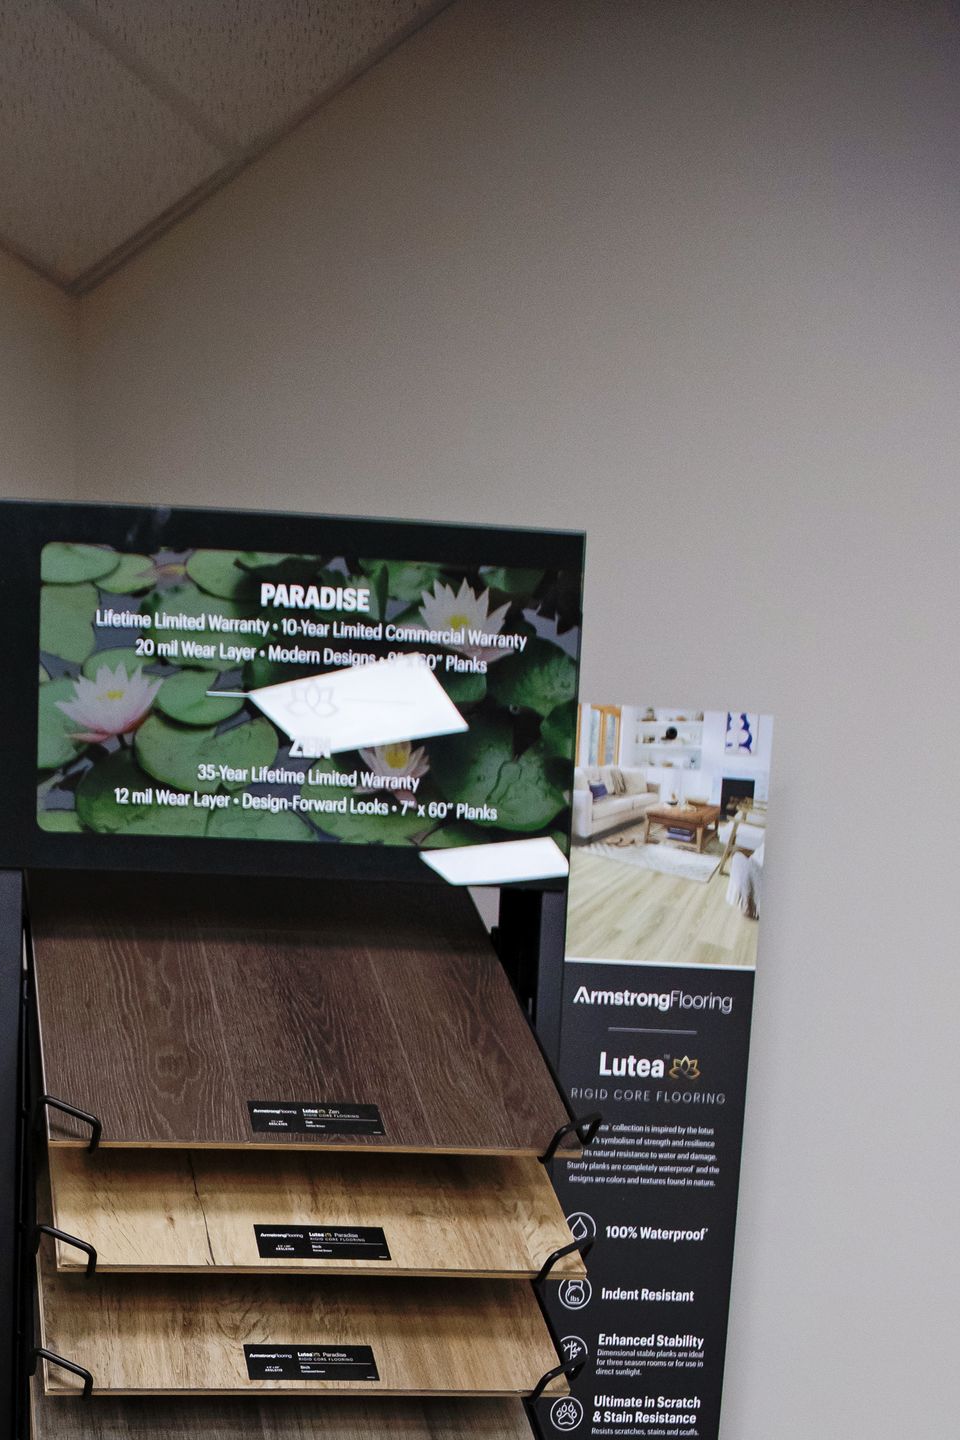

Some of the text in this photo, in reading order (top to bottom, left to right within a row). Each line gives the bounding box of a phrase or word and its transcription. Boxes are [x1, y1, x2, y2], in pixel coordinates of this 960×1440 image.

[260, 582, 370, 613] PARADISE
[95, 609, 527, 652] Lifetime Limited Warranty 10-Year Limited Commercial Warranty
[135, 638, 154, 656] 20
[157, 639, 178, 657] mil
[181, 640, 215, 658] Wear
[219, 642, 256, 663] Layer
[268, 645, 320, 664] Modern
[323, 648, 376, 667] Designs
[445, 656, 487, 674] Planks
[197, 763, 420, 792] 35-Year Lifetime Limited Warranty
[114, 787, 129, 805] 12
[132, 788, 153, 805] mil
[155, 789, 190, 806] Wear
[193, 791, 231, 811] Layer
[242, 793, 347, 815] Design-Forward
[350, 798, 389, 816] Looks
[417, 804, 426, 817] x
[428, 801, 453, 818] 60"
[456, 802, 498, 822] Planks
[572, 985, 733, 1015] ArmstrongFlooring
[570, 1087, 726, 1105] RIGID CORE FLOORING
[612, 1124, 644, 1134] collection
[645, 1125, 651, 1134] is
[651, 1125, 677, 1136] inspired
[678, 1126, 686, 1136] by
[687, 1126, 697, 1135] the
[698, 1126, 715, 1135] lotus
[601, 1136, 635, 1147] symbolism
[636, 1136, 643, 1145] of
[644, 1137, 671, 1148] strength
[672, 1138, 684, 1147] and
[685, 1139, 715, 1148] resilience
[584, 1149, 717, 1162] its natural resistance to water and damage.
[566, 1161, 588, 1171] Sturdy
[589, 1161, 610, 1171] planks
[622, 1163, 658, 1173] completely
[696, 1165, 708, 1174] and
[709, 1165, 720, 1174] the
[568, 1174, 593, 1184] designs
[606, 1175, 626, 1184] colors
[627, 1176, 639, 1184] and
[640, 1177, 666, 1185] textures
[667, 1177, 685, 1186] found
[686, 1177, 693, 1186] in
[693, 1178, 716, 1187] nature.
[605, 1225, 638, 1239] 100%
[570, 1295, 580, 1303] lbs
[601, 1287, 695, 1302] Indent Resistant
[598, 1333, 704, 1350] Enhanced Stability
[597, 1348, 704, 1359] Dimensional stable planks are ideal
[596, 1358, 606, 1366] for
[607, 1358, 623, 1367] three
[647, 1360, 667, 1368] rooms
[667, 1360, 674, 1368] or
[675, 1359, 684, 1368] for
[685, 1360, 696, 1368] use
[697, 1359, 704, 1368] in
[595, 1367, 642, 1378] direct sunlight.
[594, 1395, 701, 1410] Ultimate in Scratch
[592, 1410, 697, 1425] & Stain Resistance
[591, 1427, 699, 1437] Resists scratches, stains and scuffs.
